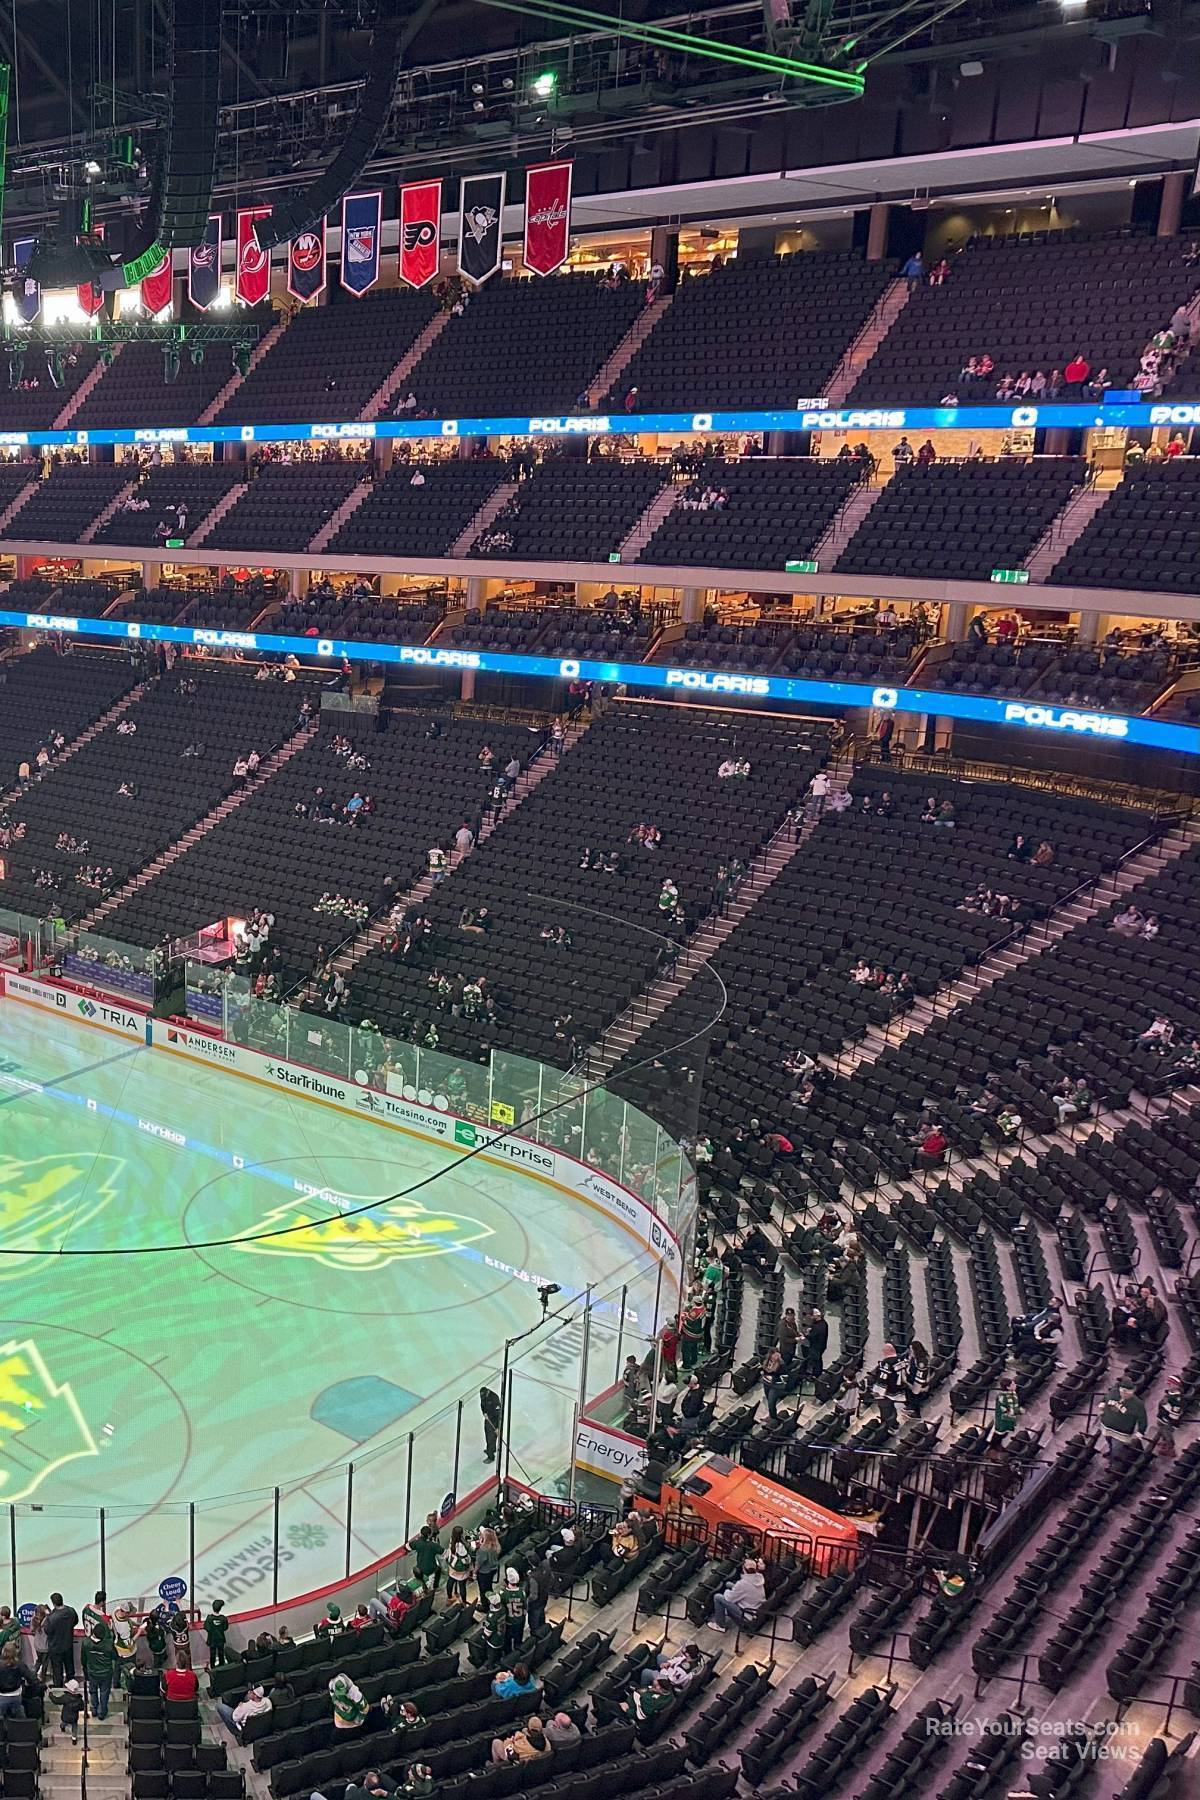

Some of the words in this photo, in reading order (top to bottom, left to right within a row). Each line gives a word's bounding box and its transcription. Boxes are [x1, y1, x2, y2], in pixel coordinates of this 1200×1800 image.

[529, 417, 610, 432] POLARIS
[802, 410, 906, 428] POLARIS
[134, 429, 188, 442] POLARIS
[311, 424, 376, 437] POLARIS
[26, 614, 78, 630] POLARIS
[193, 630, 257, 649] POLARIS
[400, 648, 481, 667] POLARIS
[666, 670, 770, 695] POLARIS
[1005, 704, 1129, 737] POLARIS
[100, 1008, 138, 1031] TRIA
[188, 1036, 236, 1058] ANDERSEN
[276, 1066, 346, 1100] StarTribune
[385, 1101, 447, 1129] TIcasino.com
[457, 1125, 553, 1169] enterprise
[592, 1183, 615, 1201] WEST
[615, 1198, 637, 1218] BEND
[575, 1432, 636, 1468] Energy
[163, 1581, 181, 1591] Cheer
[165, 1587, 181, 1596] Loud
[507, 1602, 523, 1617] 15
[175, 1634, 188, 1643] 20
